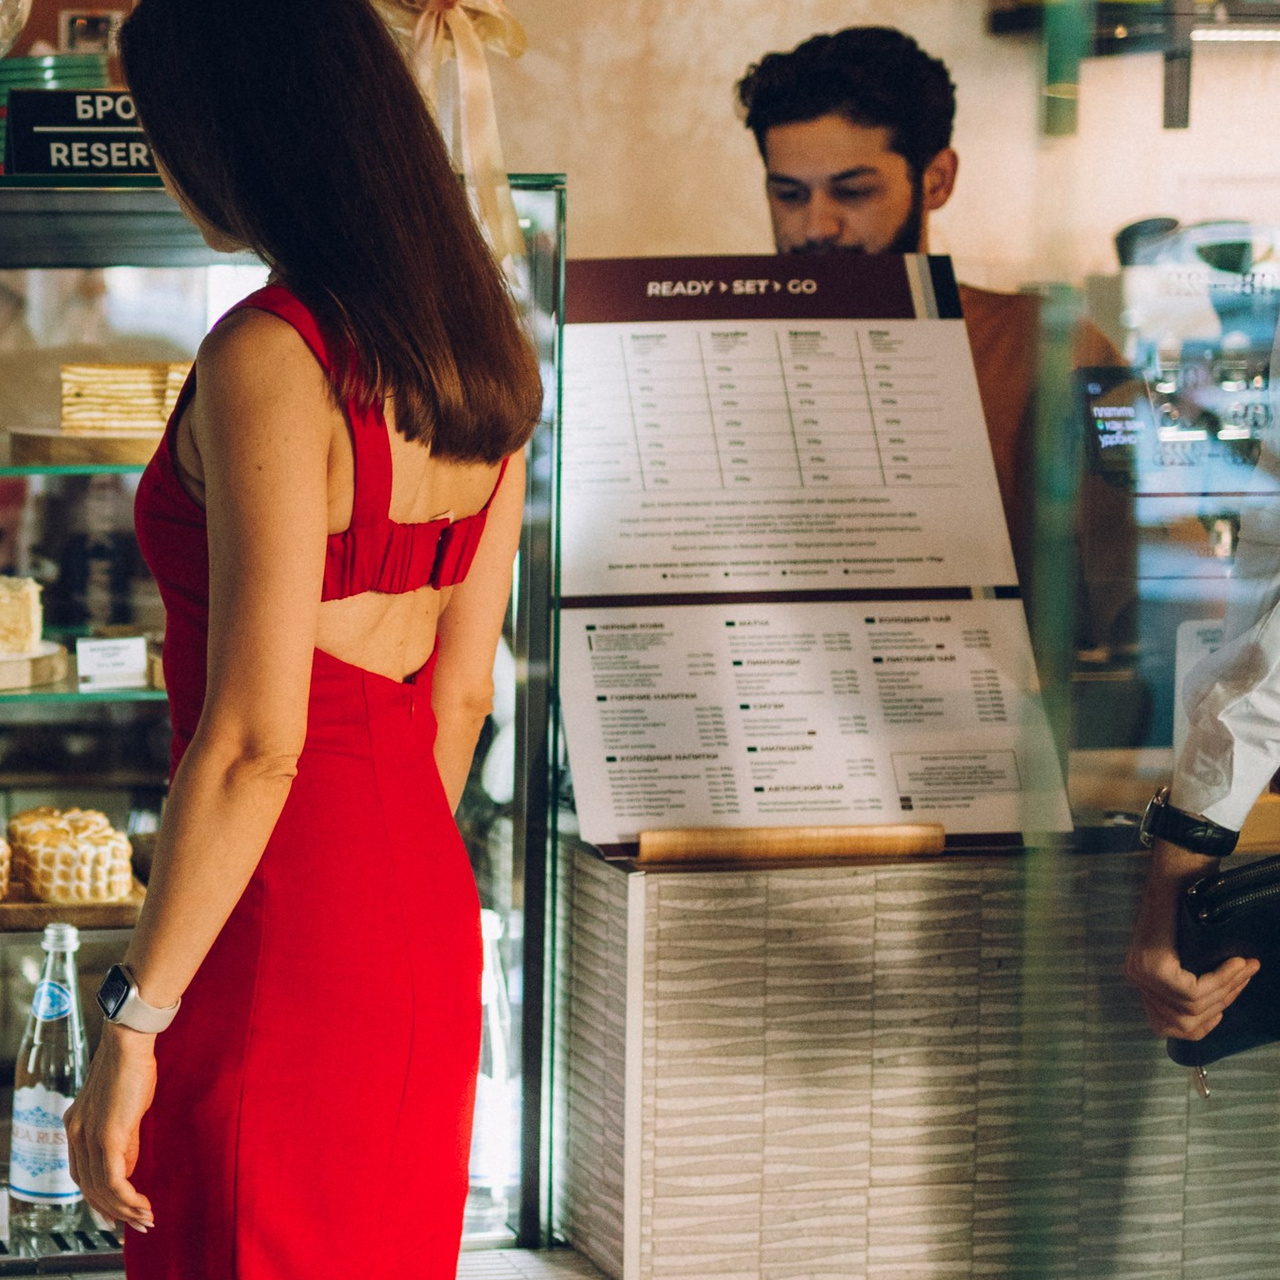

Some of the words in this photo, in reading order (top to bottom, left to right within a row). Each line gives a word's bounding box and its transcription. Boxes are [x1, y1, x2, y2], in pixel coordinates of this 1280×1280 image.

[75, 95, 136, 119] БРО
[49, 142, 150, 167] RESER
[647, 280, 713, 297] READY
[732, 280, 769, 295] SET
[787, 279, 818, 294] GO
